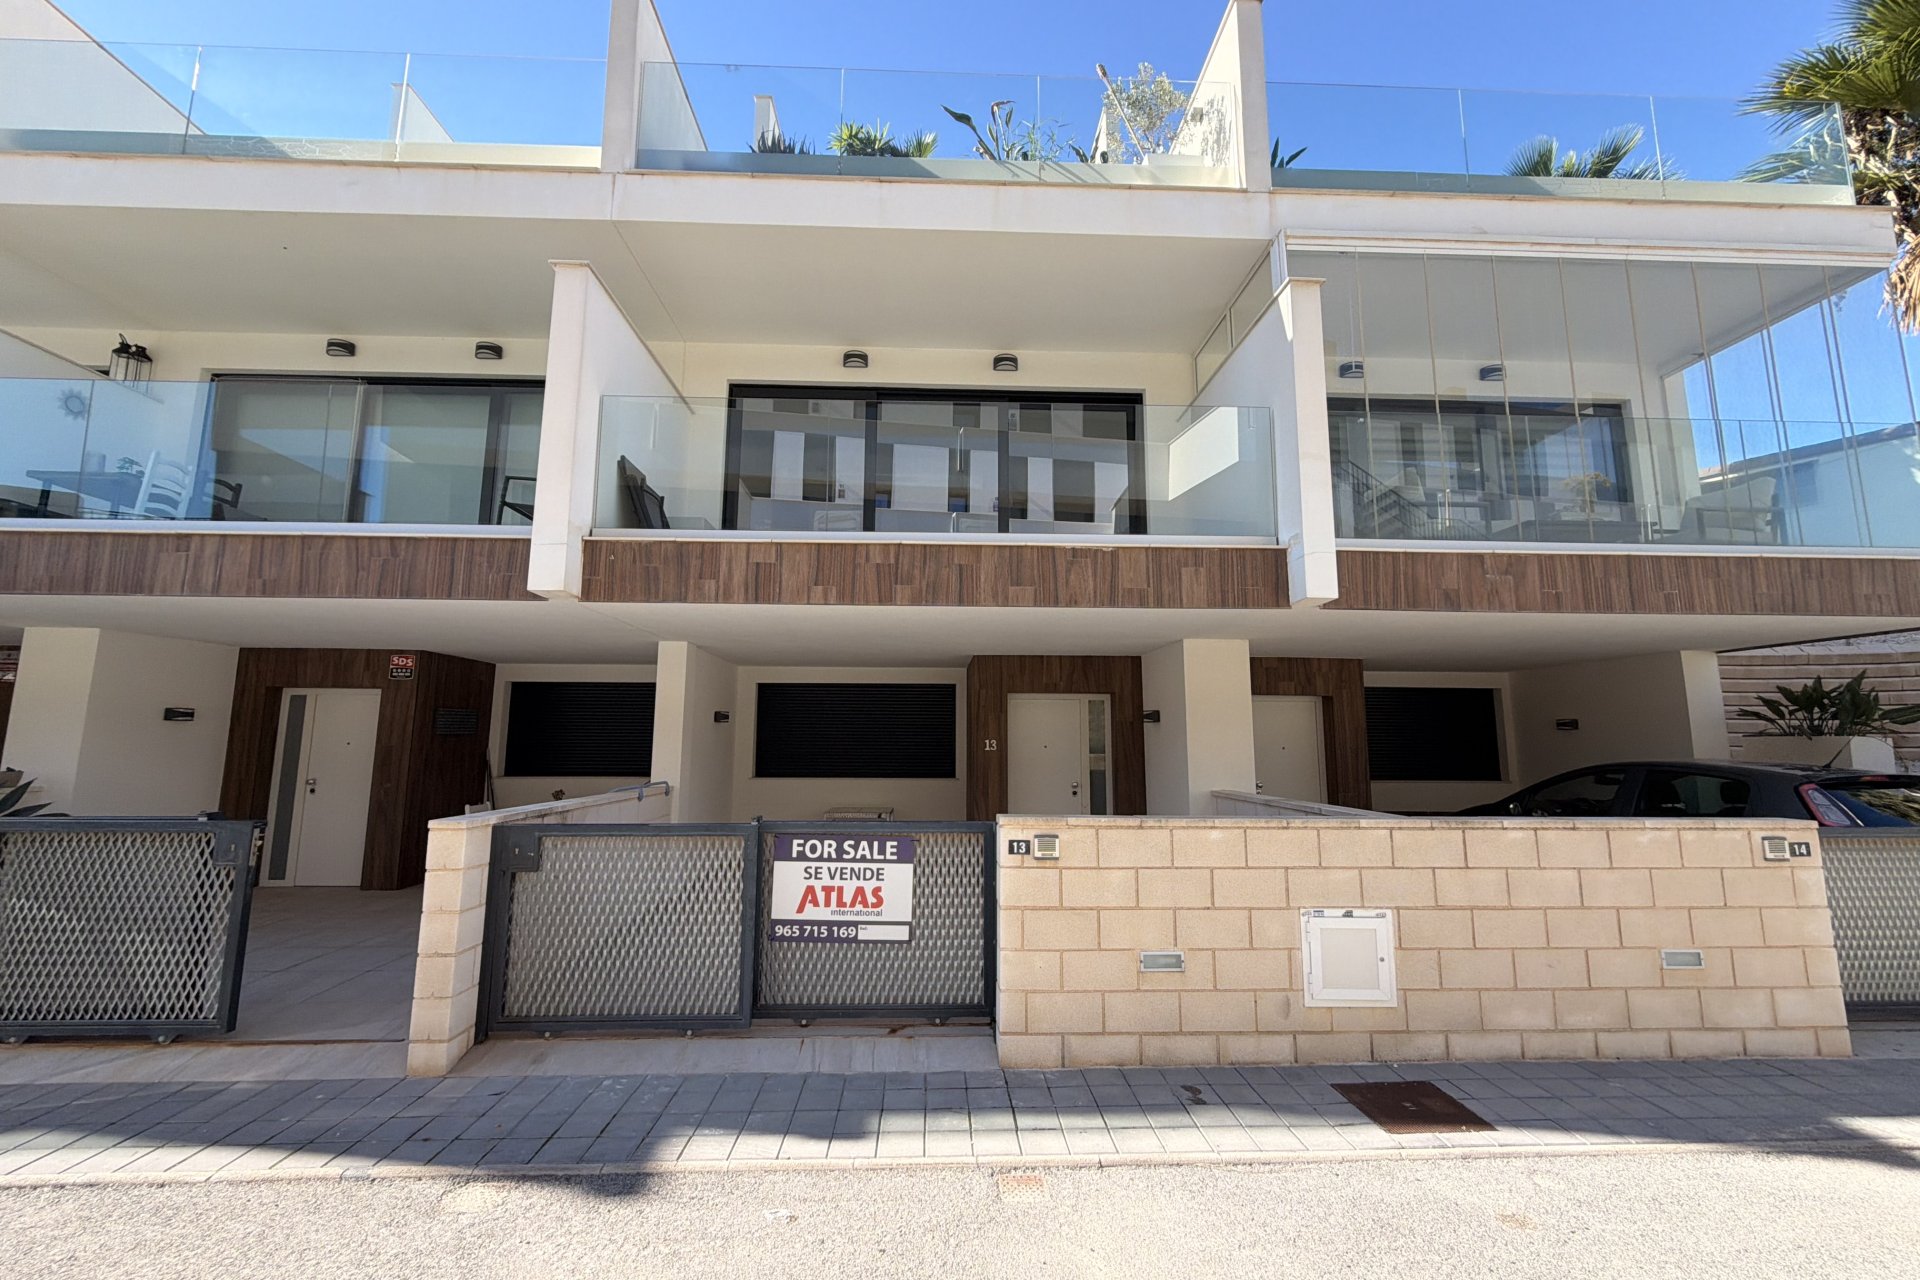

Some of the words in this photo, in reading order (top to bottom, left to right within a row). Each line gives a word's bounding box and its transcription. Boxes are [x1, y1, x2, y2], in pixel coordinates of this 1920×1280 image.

[984, 739, 997, 751] 13
[791, 839, 837, 859] FOR
[842, 840, 898, 860] SALE
[1012, 841, 1026, 854] 13
[1793, 844, 1807, 856] 14
[803, 866, 823, 880] SE
[827, 866, 885, 881] VENDE
[795, 885, 884, 914] ATLAS
[830, 908, 883, 917] international
[774, 924, 800, 937] 965
[803, 925, 828, 938] 715
[832, 926, 856, 938] 169
